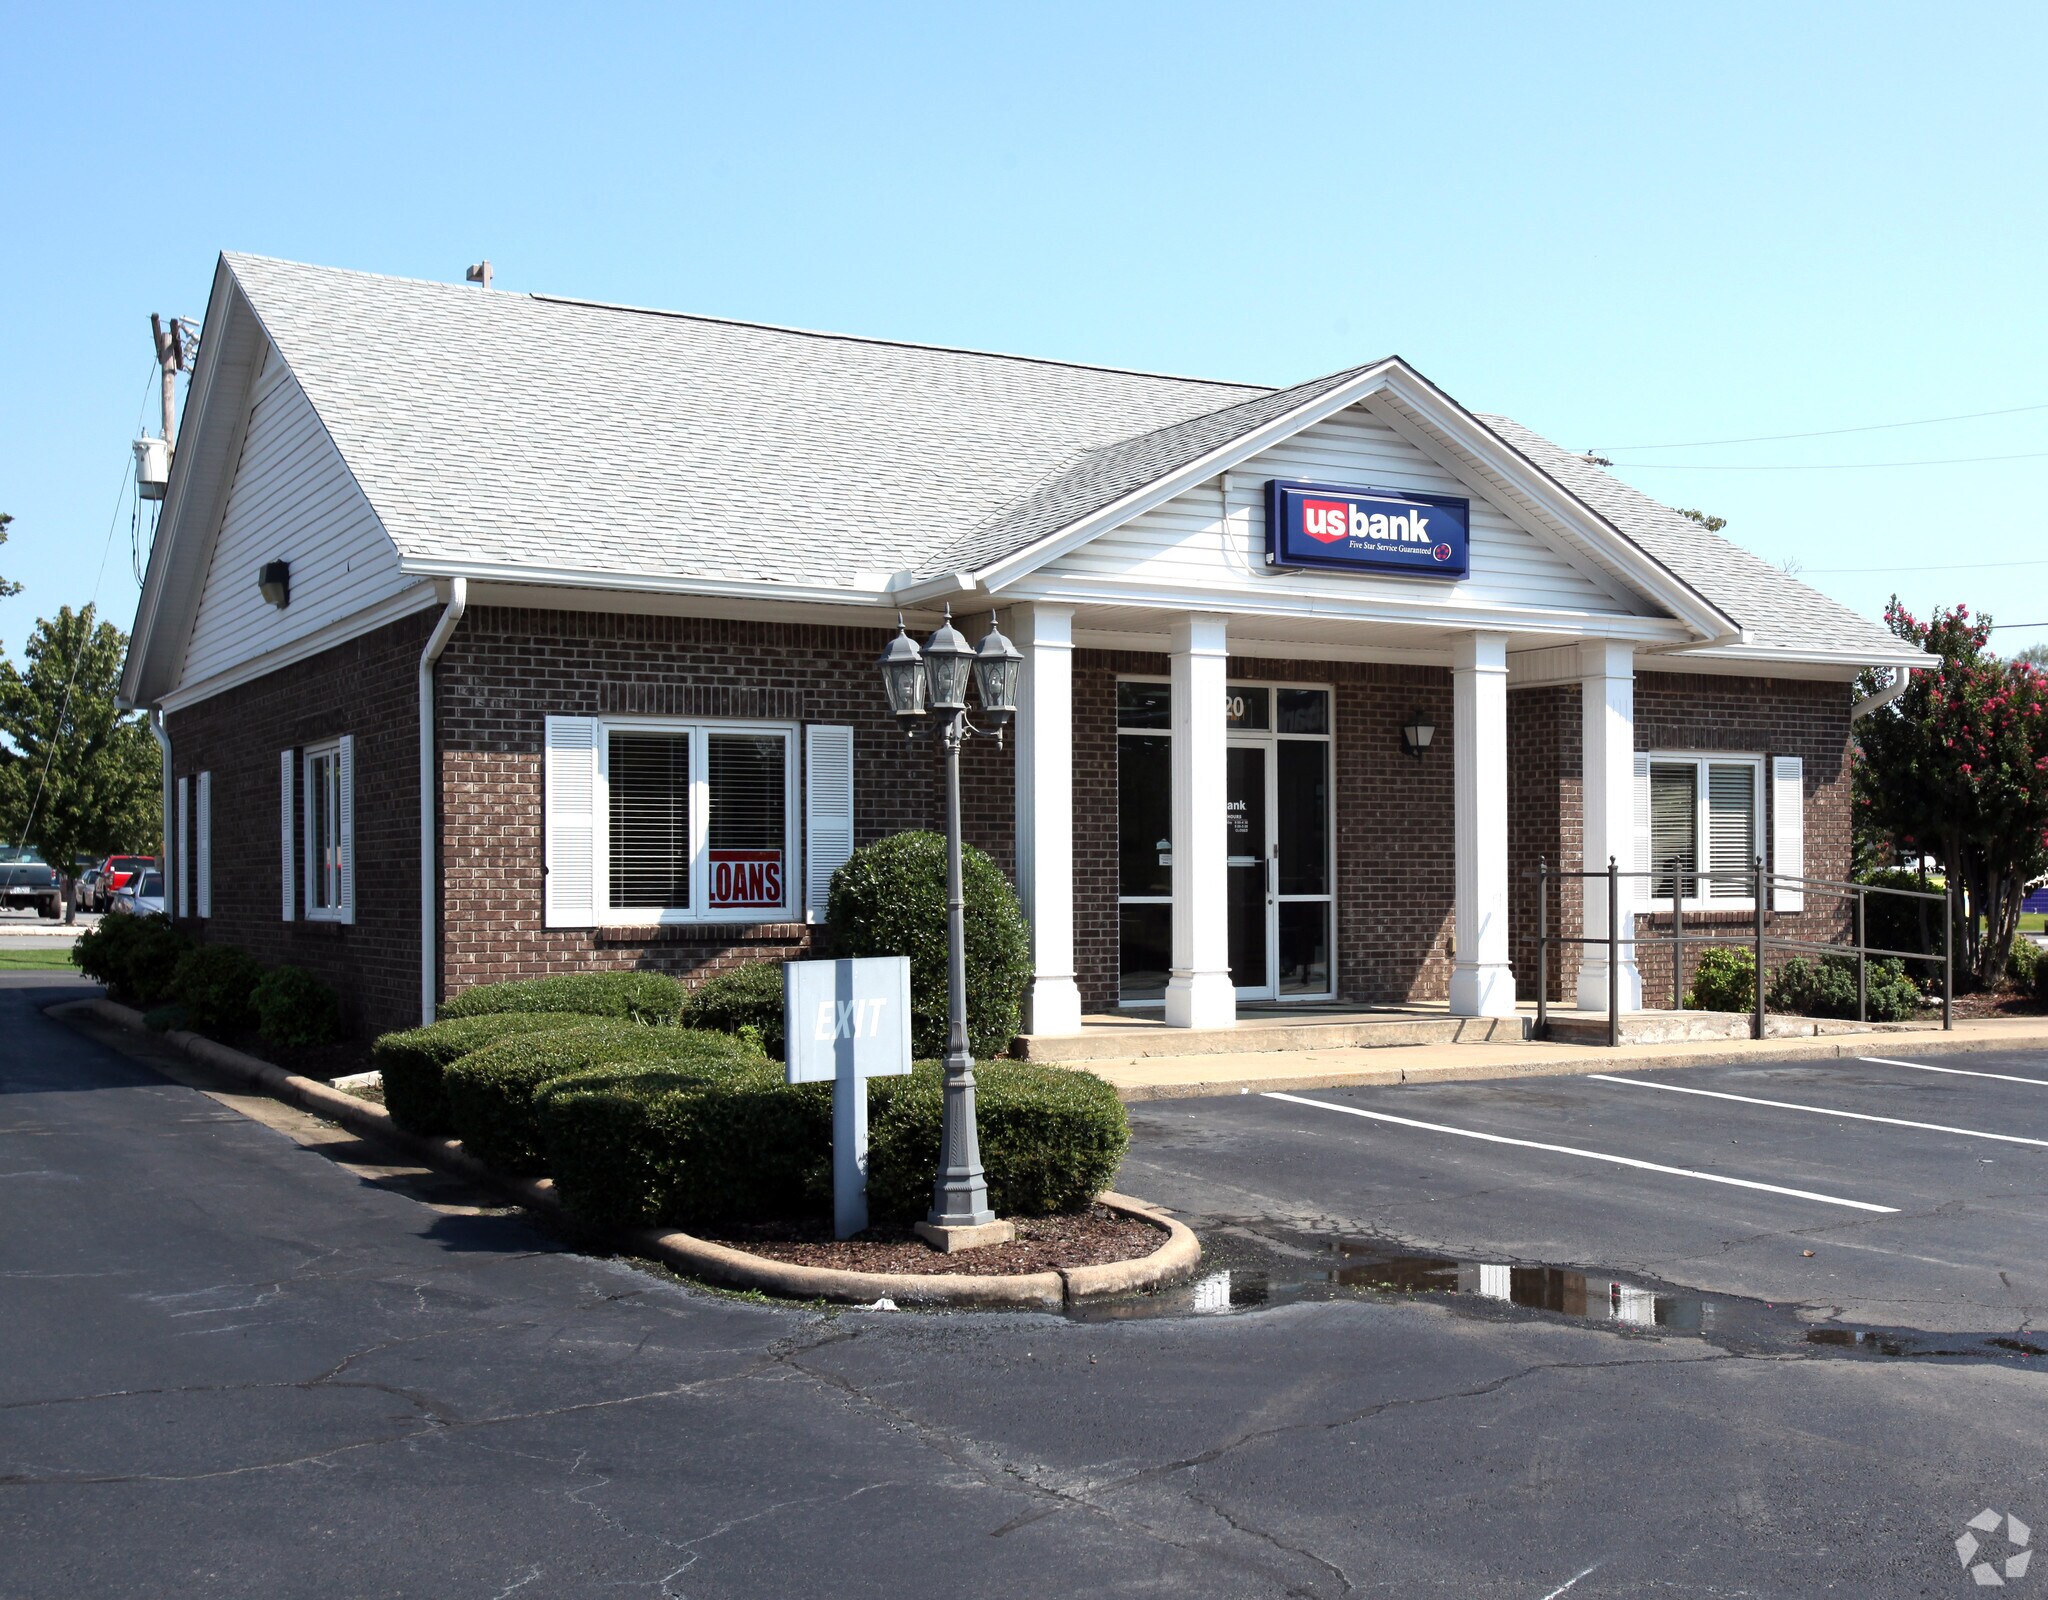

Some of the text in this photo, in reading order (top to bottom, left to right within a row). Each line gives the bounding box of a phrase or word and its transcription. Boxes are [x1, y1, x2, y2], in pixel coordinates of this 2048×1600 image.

[1349, 540, 1431, 555] Five Star Service Guaranteed
[815, 998, 887, 1040] EXIT
